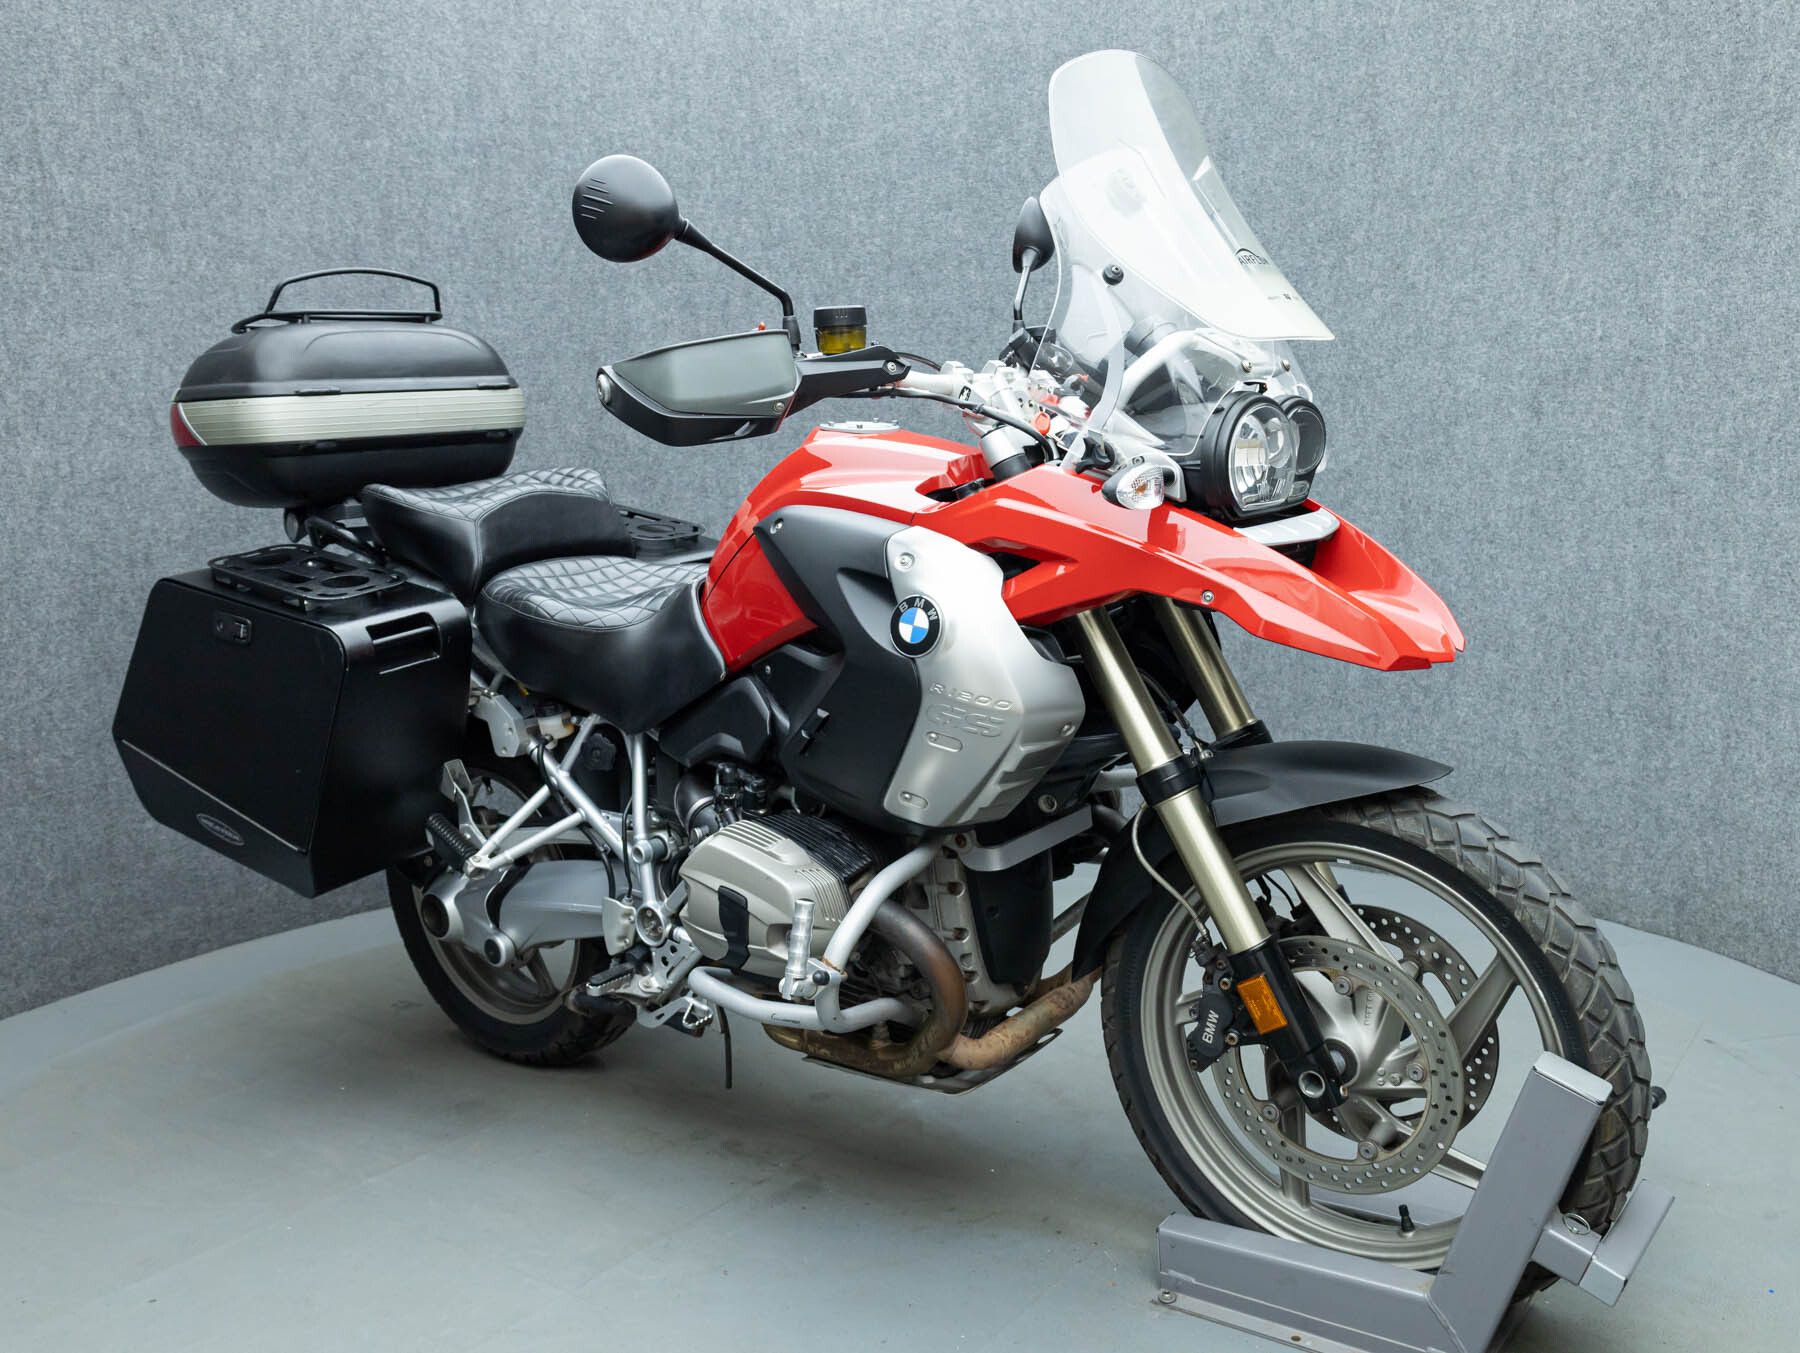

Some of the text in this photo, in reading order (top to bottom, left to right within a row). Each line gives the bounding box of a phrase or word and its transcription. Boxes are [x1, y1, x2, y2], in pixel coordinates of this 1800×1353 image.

[899, 597, 938, 621] BMW
[928, 682, 1013, 711] R 1200
[1202, 1009, 1219, 1044] BMW
